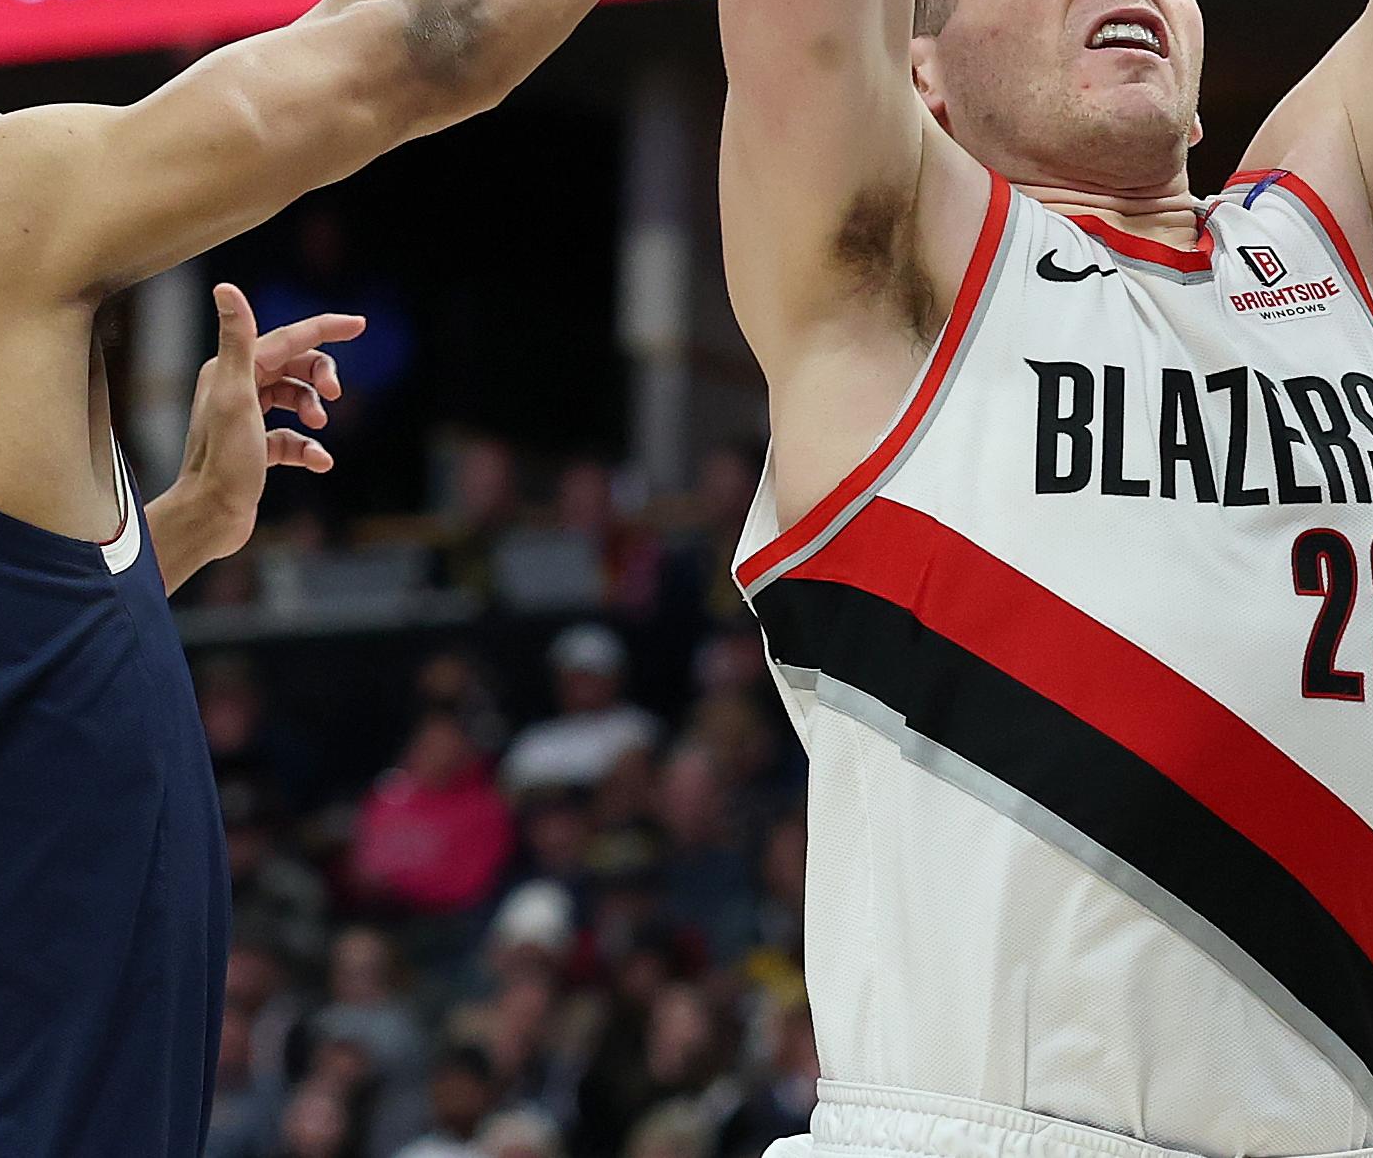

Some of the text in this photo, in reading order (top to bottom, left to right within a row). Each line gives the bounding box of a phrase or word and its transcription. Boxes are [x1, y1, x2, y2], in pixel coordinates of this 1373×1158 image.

[1252, 252, 1279, 278] B
[1229, 276, 1340, 312] BRIGHTSIDE
[1259, 303, 1326, 320] WINDOWS
